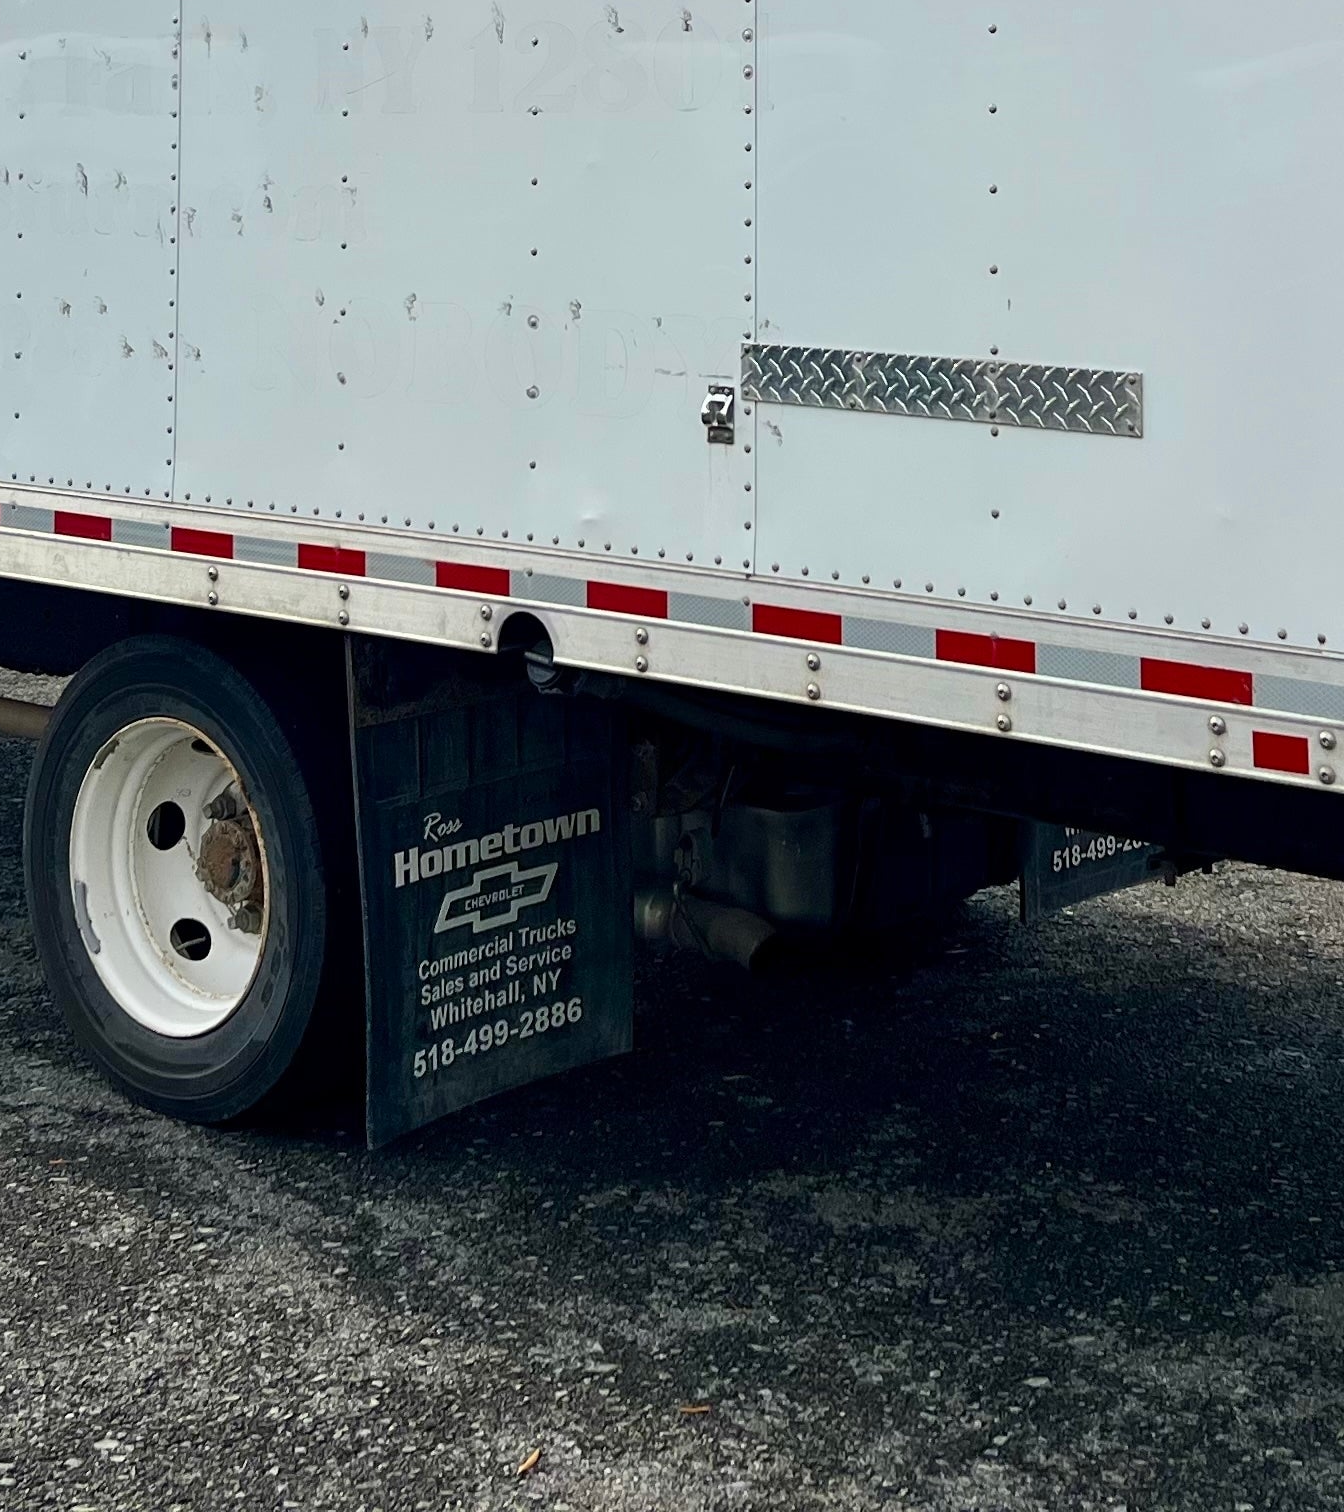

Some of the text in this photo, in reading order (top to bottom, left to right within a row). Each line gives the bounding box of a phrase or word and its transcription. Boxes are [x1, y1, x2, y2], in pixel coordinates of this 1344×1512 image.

[394, 808, 600, 888] Hometown
[424, 812, 463, 842] Ross
[465, 884, 525, 911] CHEVROLET
[419, 918, 576, 980] Commercial Trucks
[421, 945, 572, 1005] Sales and Service
[431, 968, 562, 1031] Whitehall, NY
[413, 997, 582, 1078] 518-499-2886
